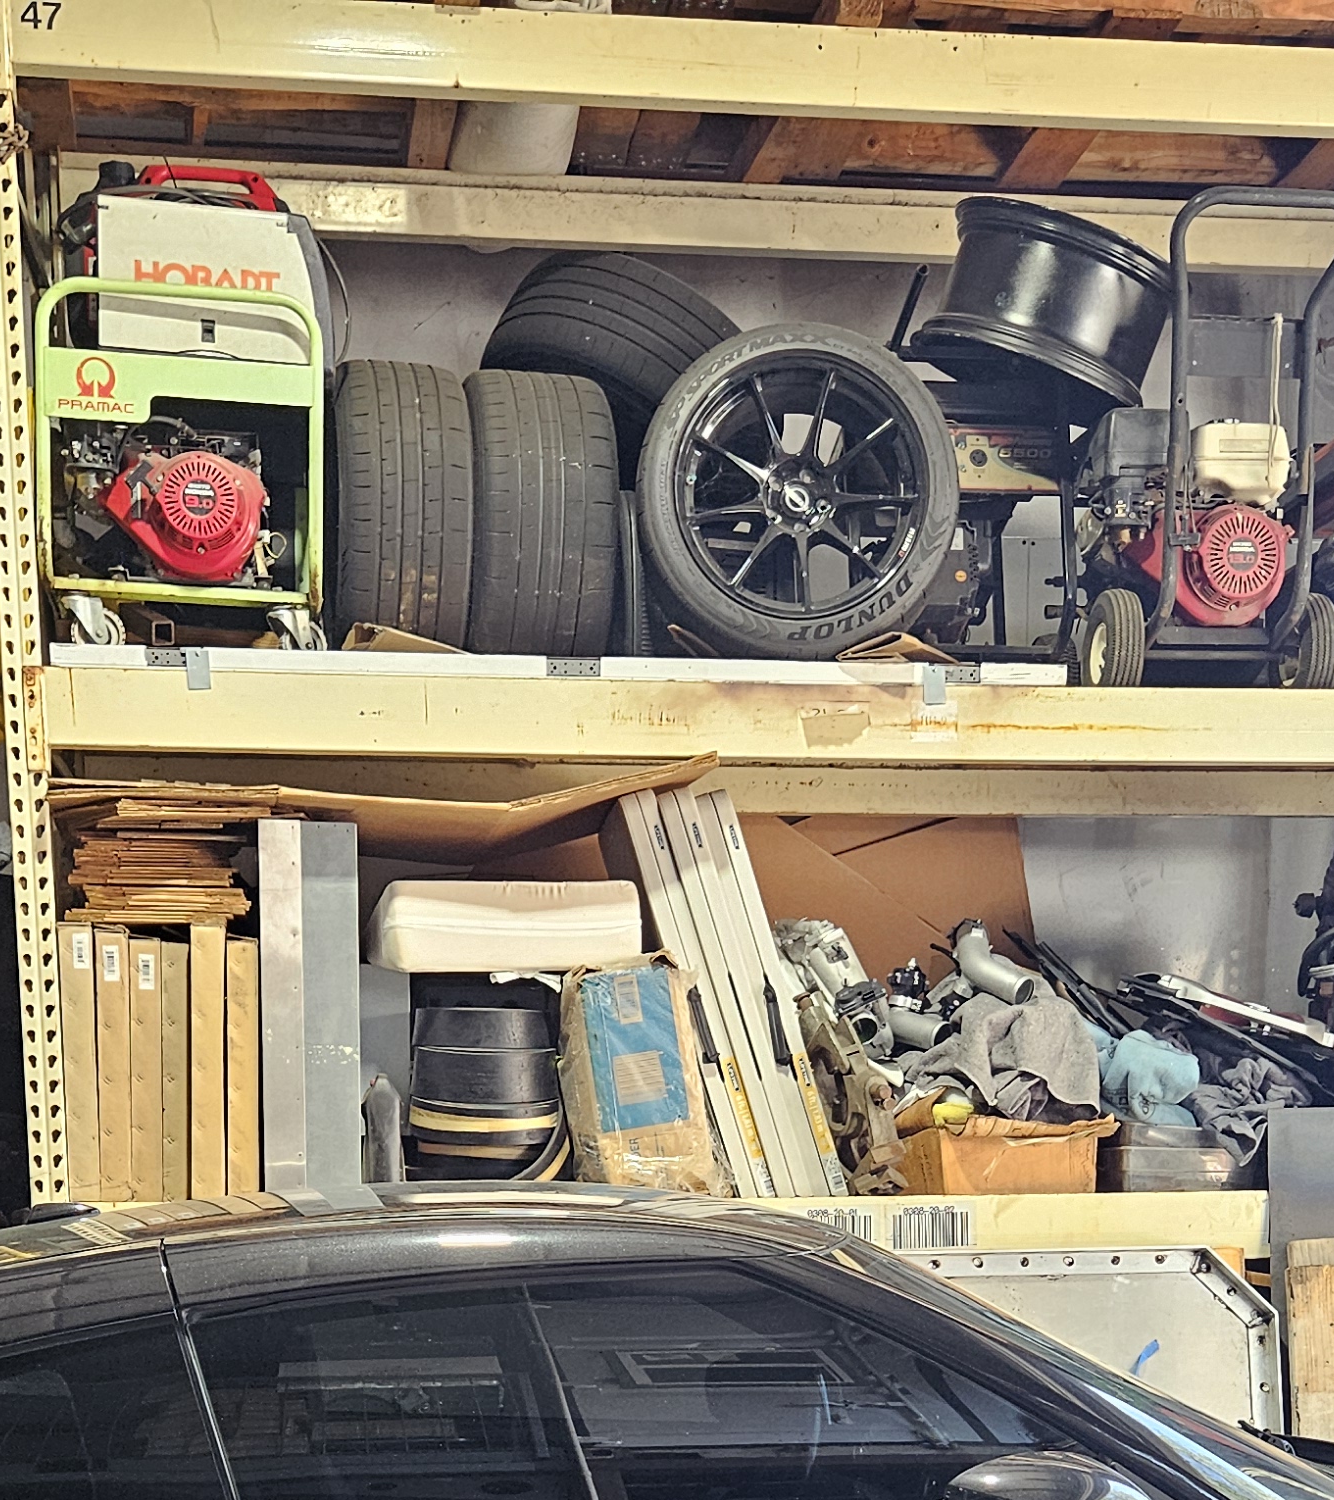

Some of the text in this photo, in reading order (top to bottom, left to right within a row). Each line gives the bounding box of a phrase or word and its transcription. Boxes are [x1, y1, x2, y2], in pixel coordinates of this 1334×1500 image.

[20, 1, 62, 30] 47
[57, 398, 134, 414] PRAMAC
[787, 570, 914, 641] DUNLOP
